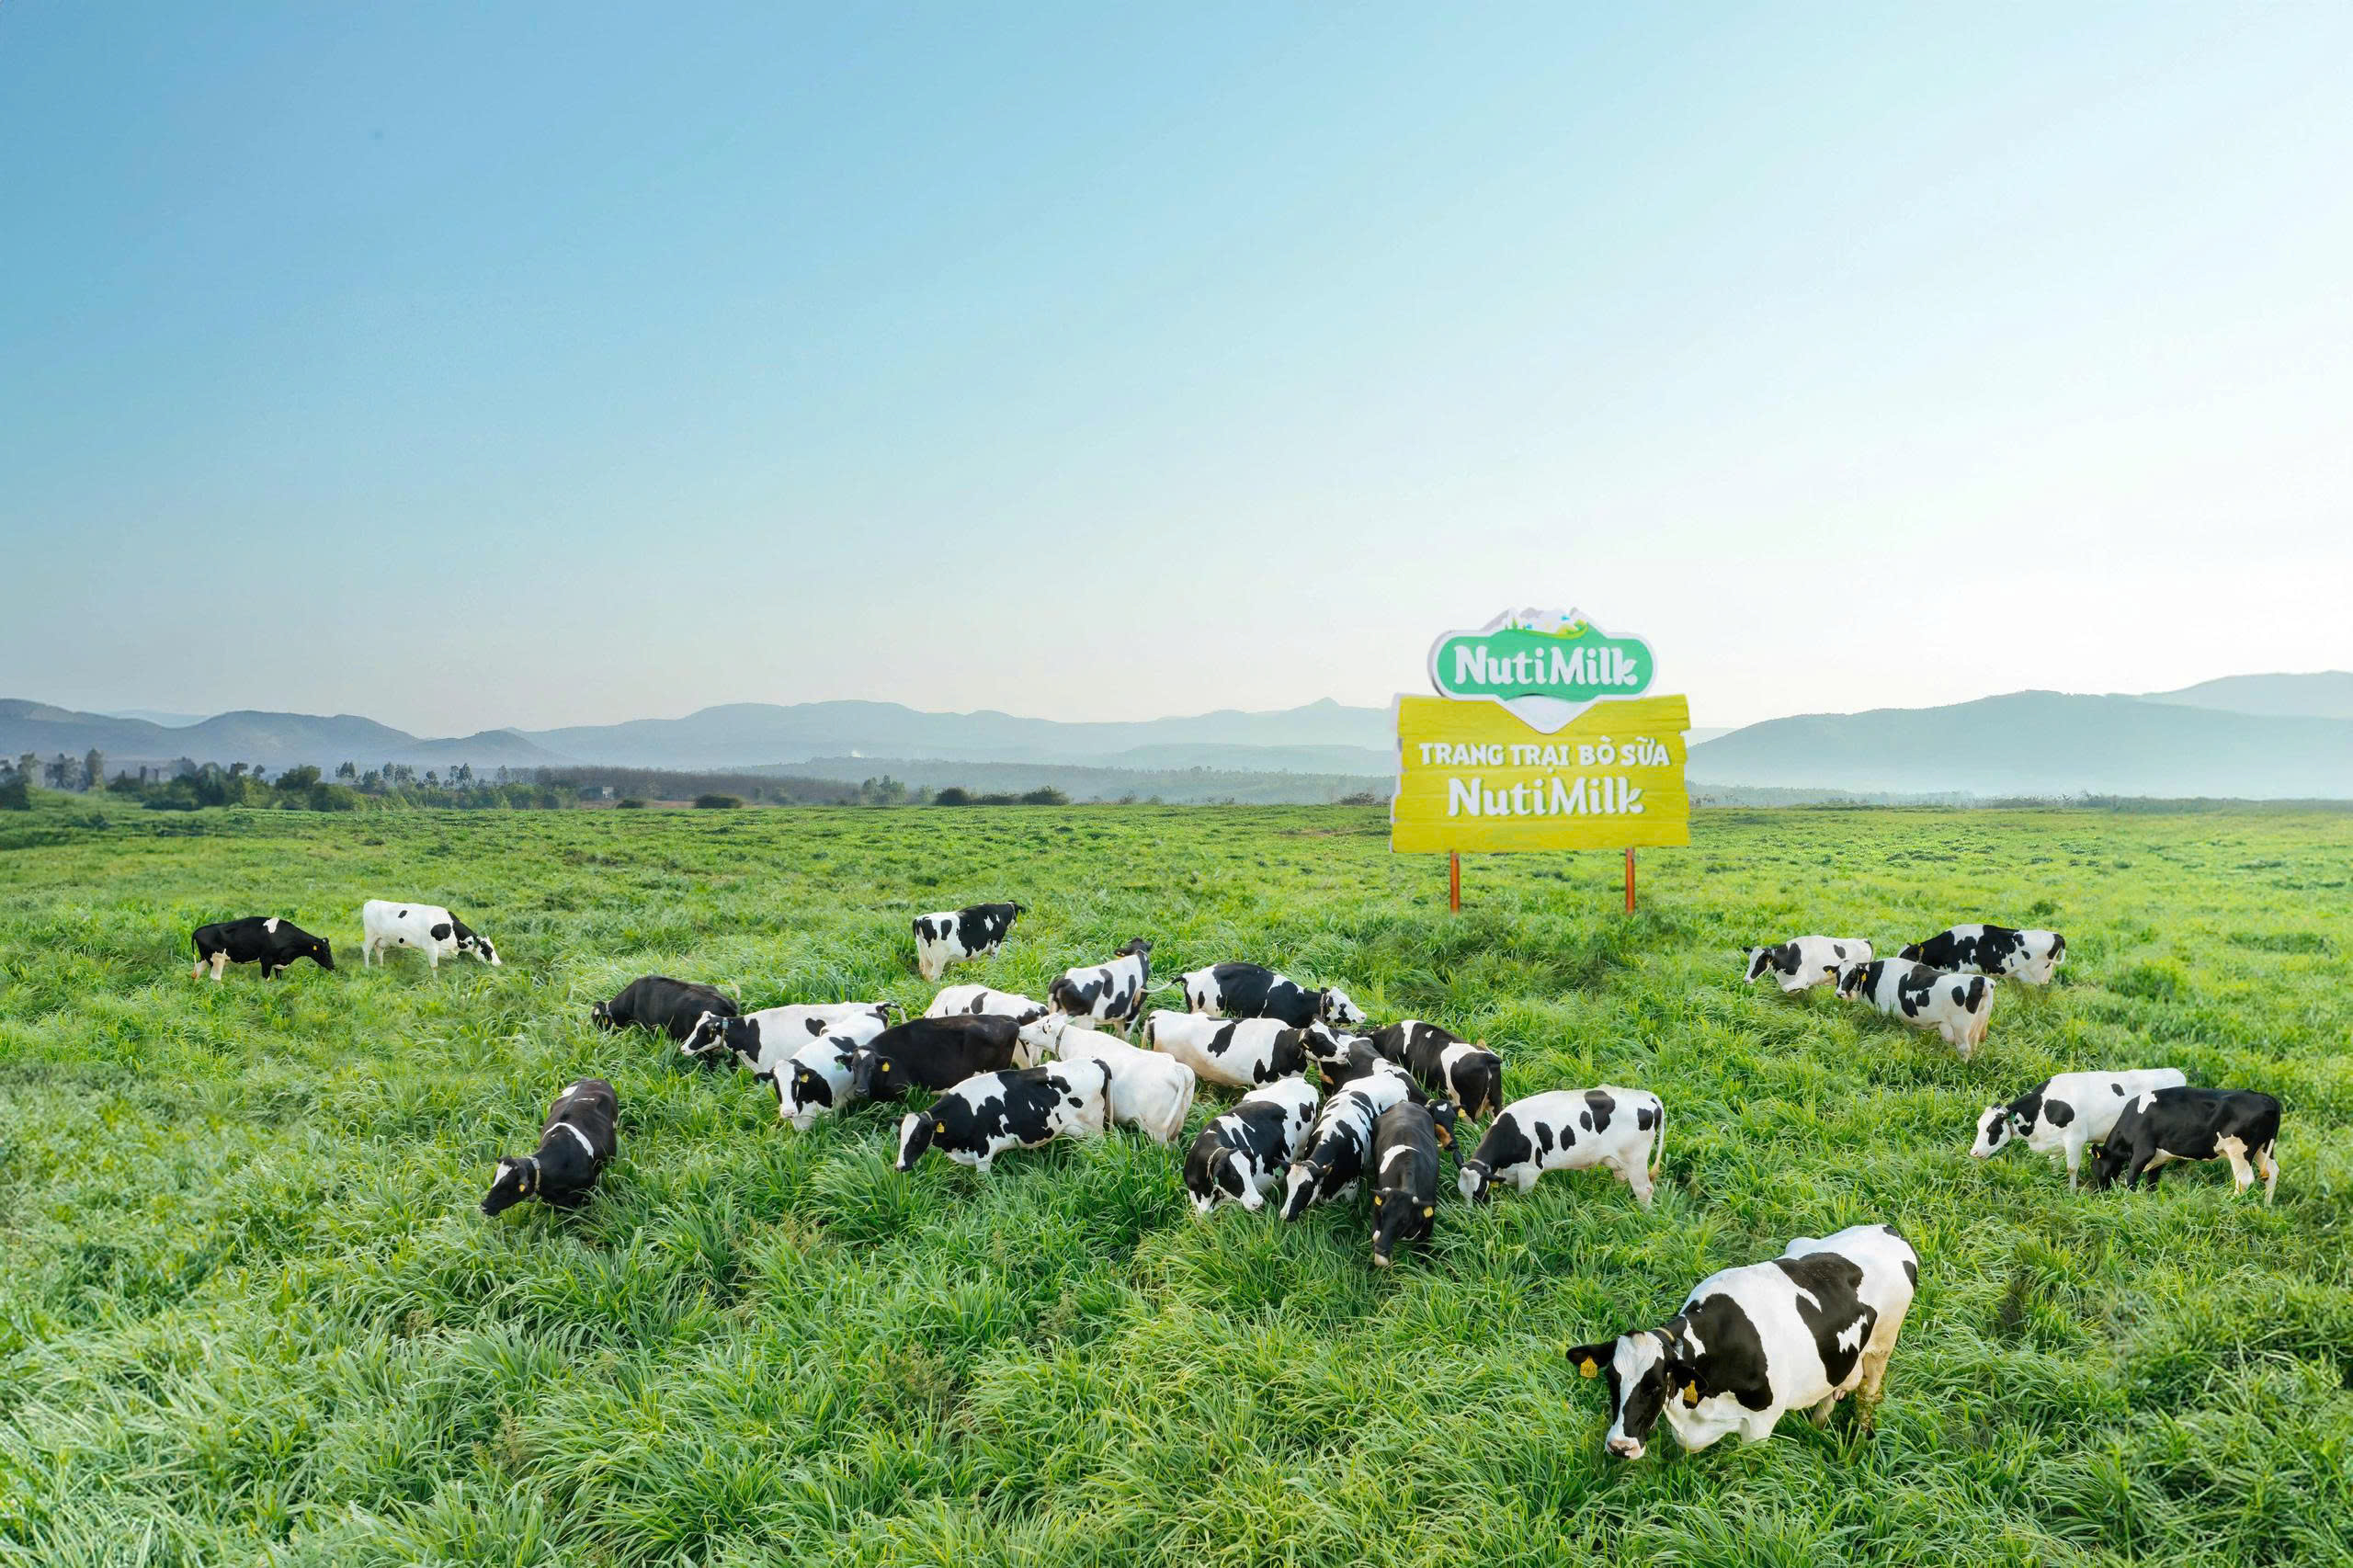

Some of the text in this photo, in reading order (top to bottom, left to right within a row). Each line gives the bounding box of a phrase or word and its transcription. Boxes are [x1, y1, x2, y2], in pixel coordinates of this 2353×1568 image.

[1454, 645, 1638, 686] NutiMilk
[1418, 735, 1671, 773] TRANG TRẠI BÒ SỮA
[1448, 777, 1645, 816] NutiMilk
